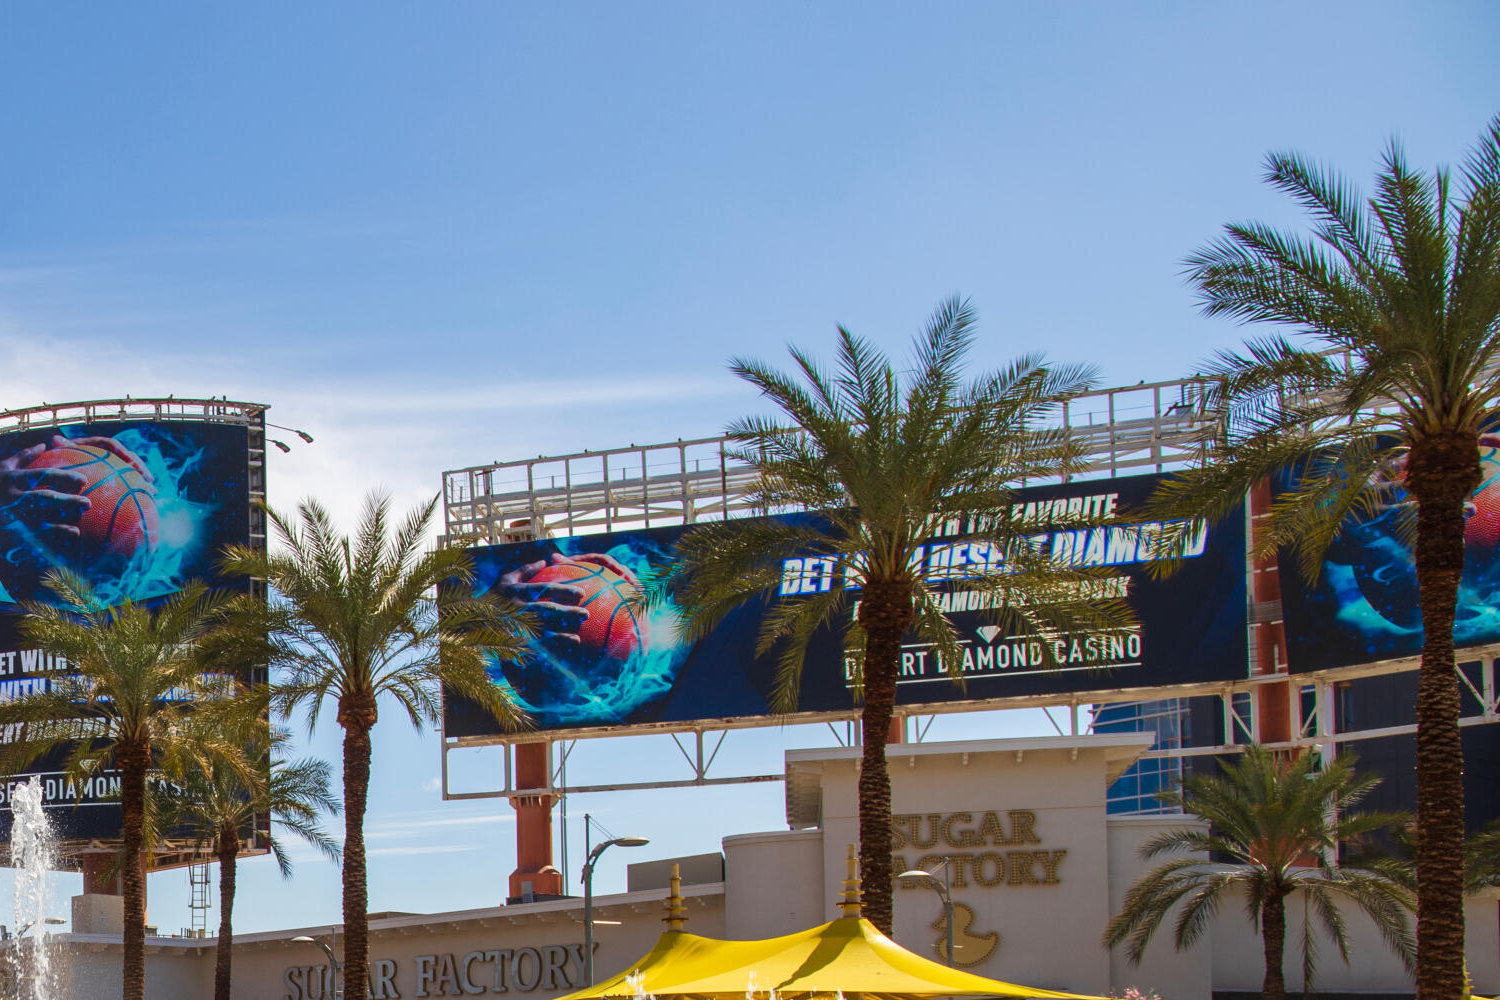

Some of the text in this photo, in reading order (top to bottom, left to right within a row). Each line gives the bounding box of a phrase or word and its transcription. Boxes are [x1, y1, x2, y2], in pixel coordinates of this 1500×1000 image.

[1011, 493, 1119, 526] FAVORITE
[778, 553, 840, 597] BET
[925, 532, 1049, 583] DESET
[920, 586, 1005, 615] AMOND
[20, 648, 68, 673] WITH
[937, 642, 1043, 674] DAMOND
[1054, 633, 1142, 664] CASINO
[46, 776, 122, 800] DIAMON
[891, 810, 1041, 850] SUGAR
[891, 849, 1067, 890] ACTORY
[414, 942, 600, 997] FACTORY
